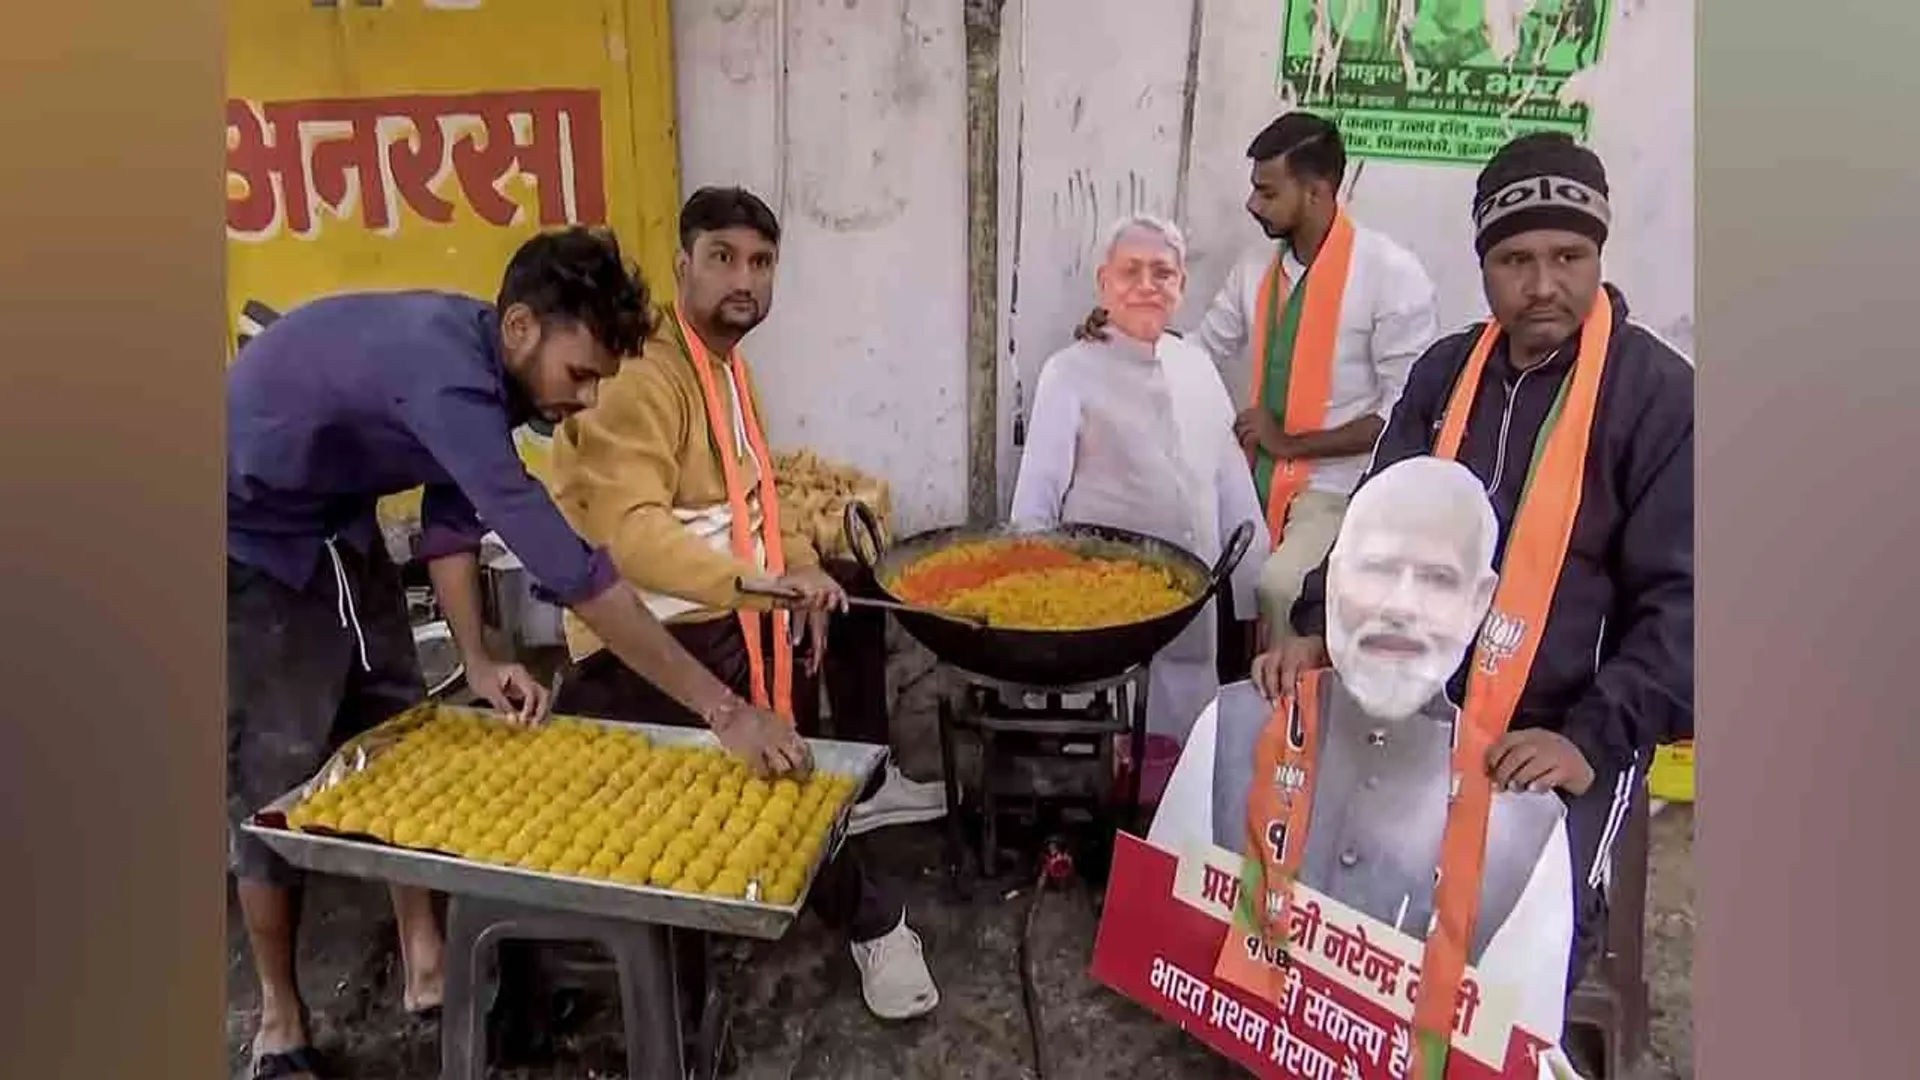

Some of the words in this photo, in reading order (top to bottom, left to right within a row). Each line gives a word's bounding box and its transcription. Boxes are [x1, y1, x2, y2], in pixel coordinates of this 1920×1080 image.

[227, 88, 606, 243] अनरसा
[1323, 923, 1406, 996] नरेन्द्र
[1149, 956, 1211, 1017] भारत
[1208, 988, 1270, 1053] प्रथम
[1270, 1016, 1338, 1080] प्रेरणा
[1303, 983, 1388, 1067] संकल्प
